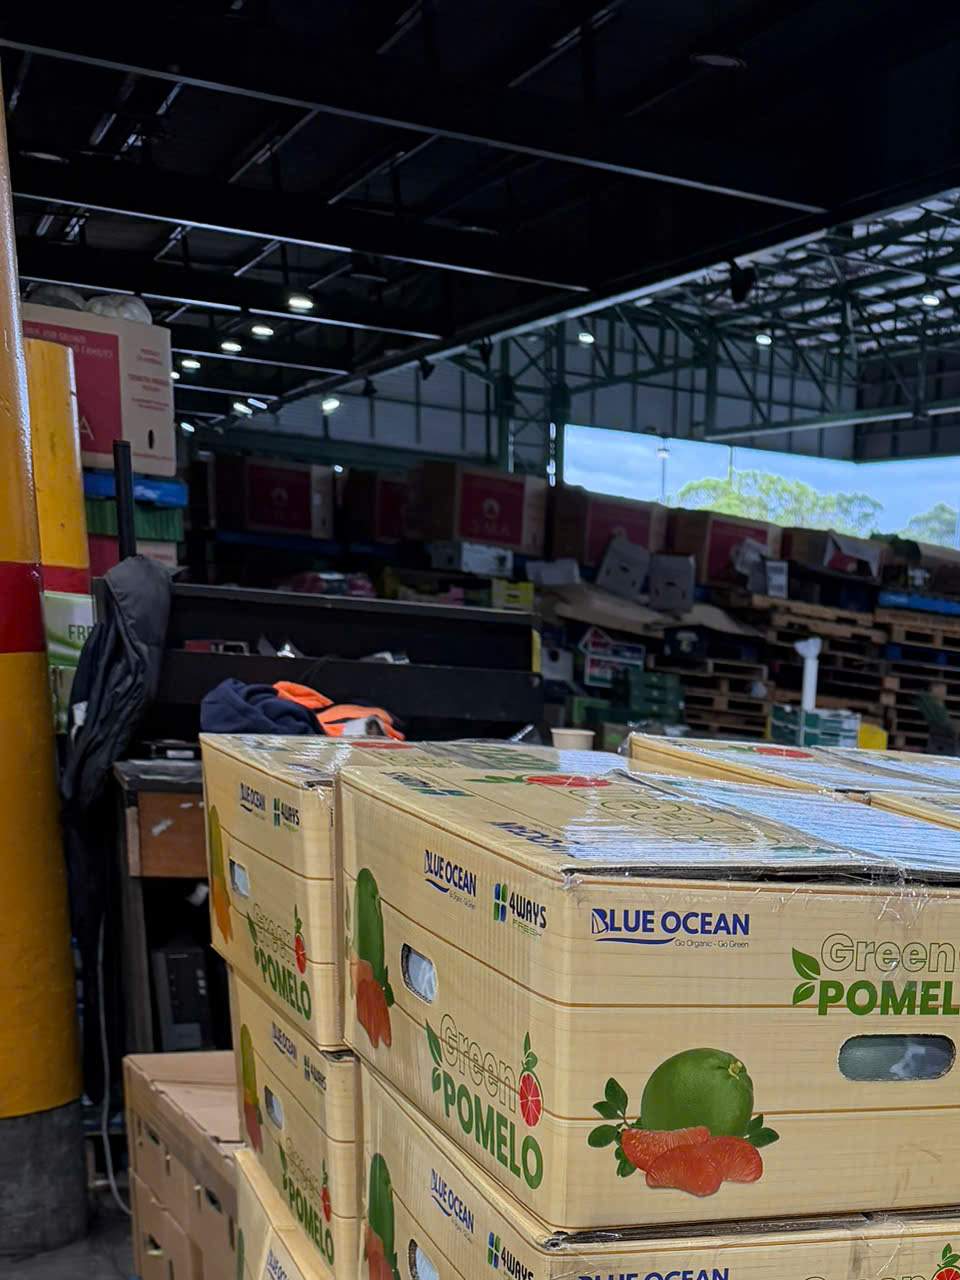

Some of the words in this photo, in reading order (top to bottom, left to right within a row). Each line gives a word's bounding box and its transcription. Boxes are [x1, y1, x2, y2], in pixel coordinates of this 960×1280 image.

[424, 849, 444, 878] BLUE
[445, 858, 477, 898] OCEAN
[508, 894, 547, 930] 4WAYS
[592, 908, 655, 934] BLUE
[661, 911, 750, 935] OCEAN
[821, 933, 955, 973] Green
[259, 953, 312, 1021] POMELO
[440, 1013, 517, 1115] Green
[443, 1074, 544, 1190] POMELO
[431, 1168, 448, 1201] BLUE
[448, 1189, 475, 1234] OCEAN
